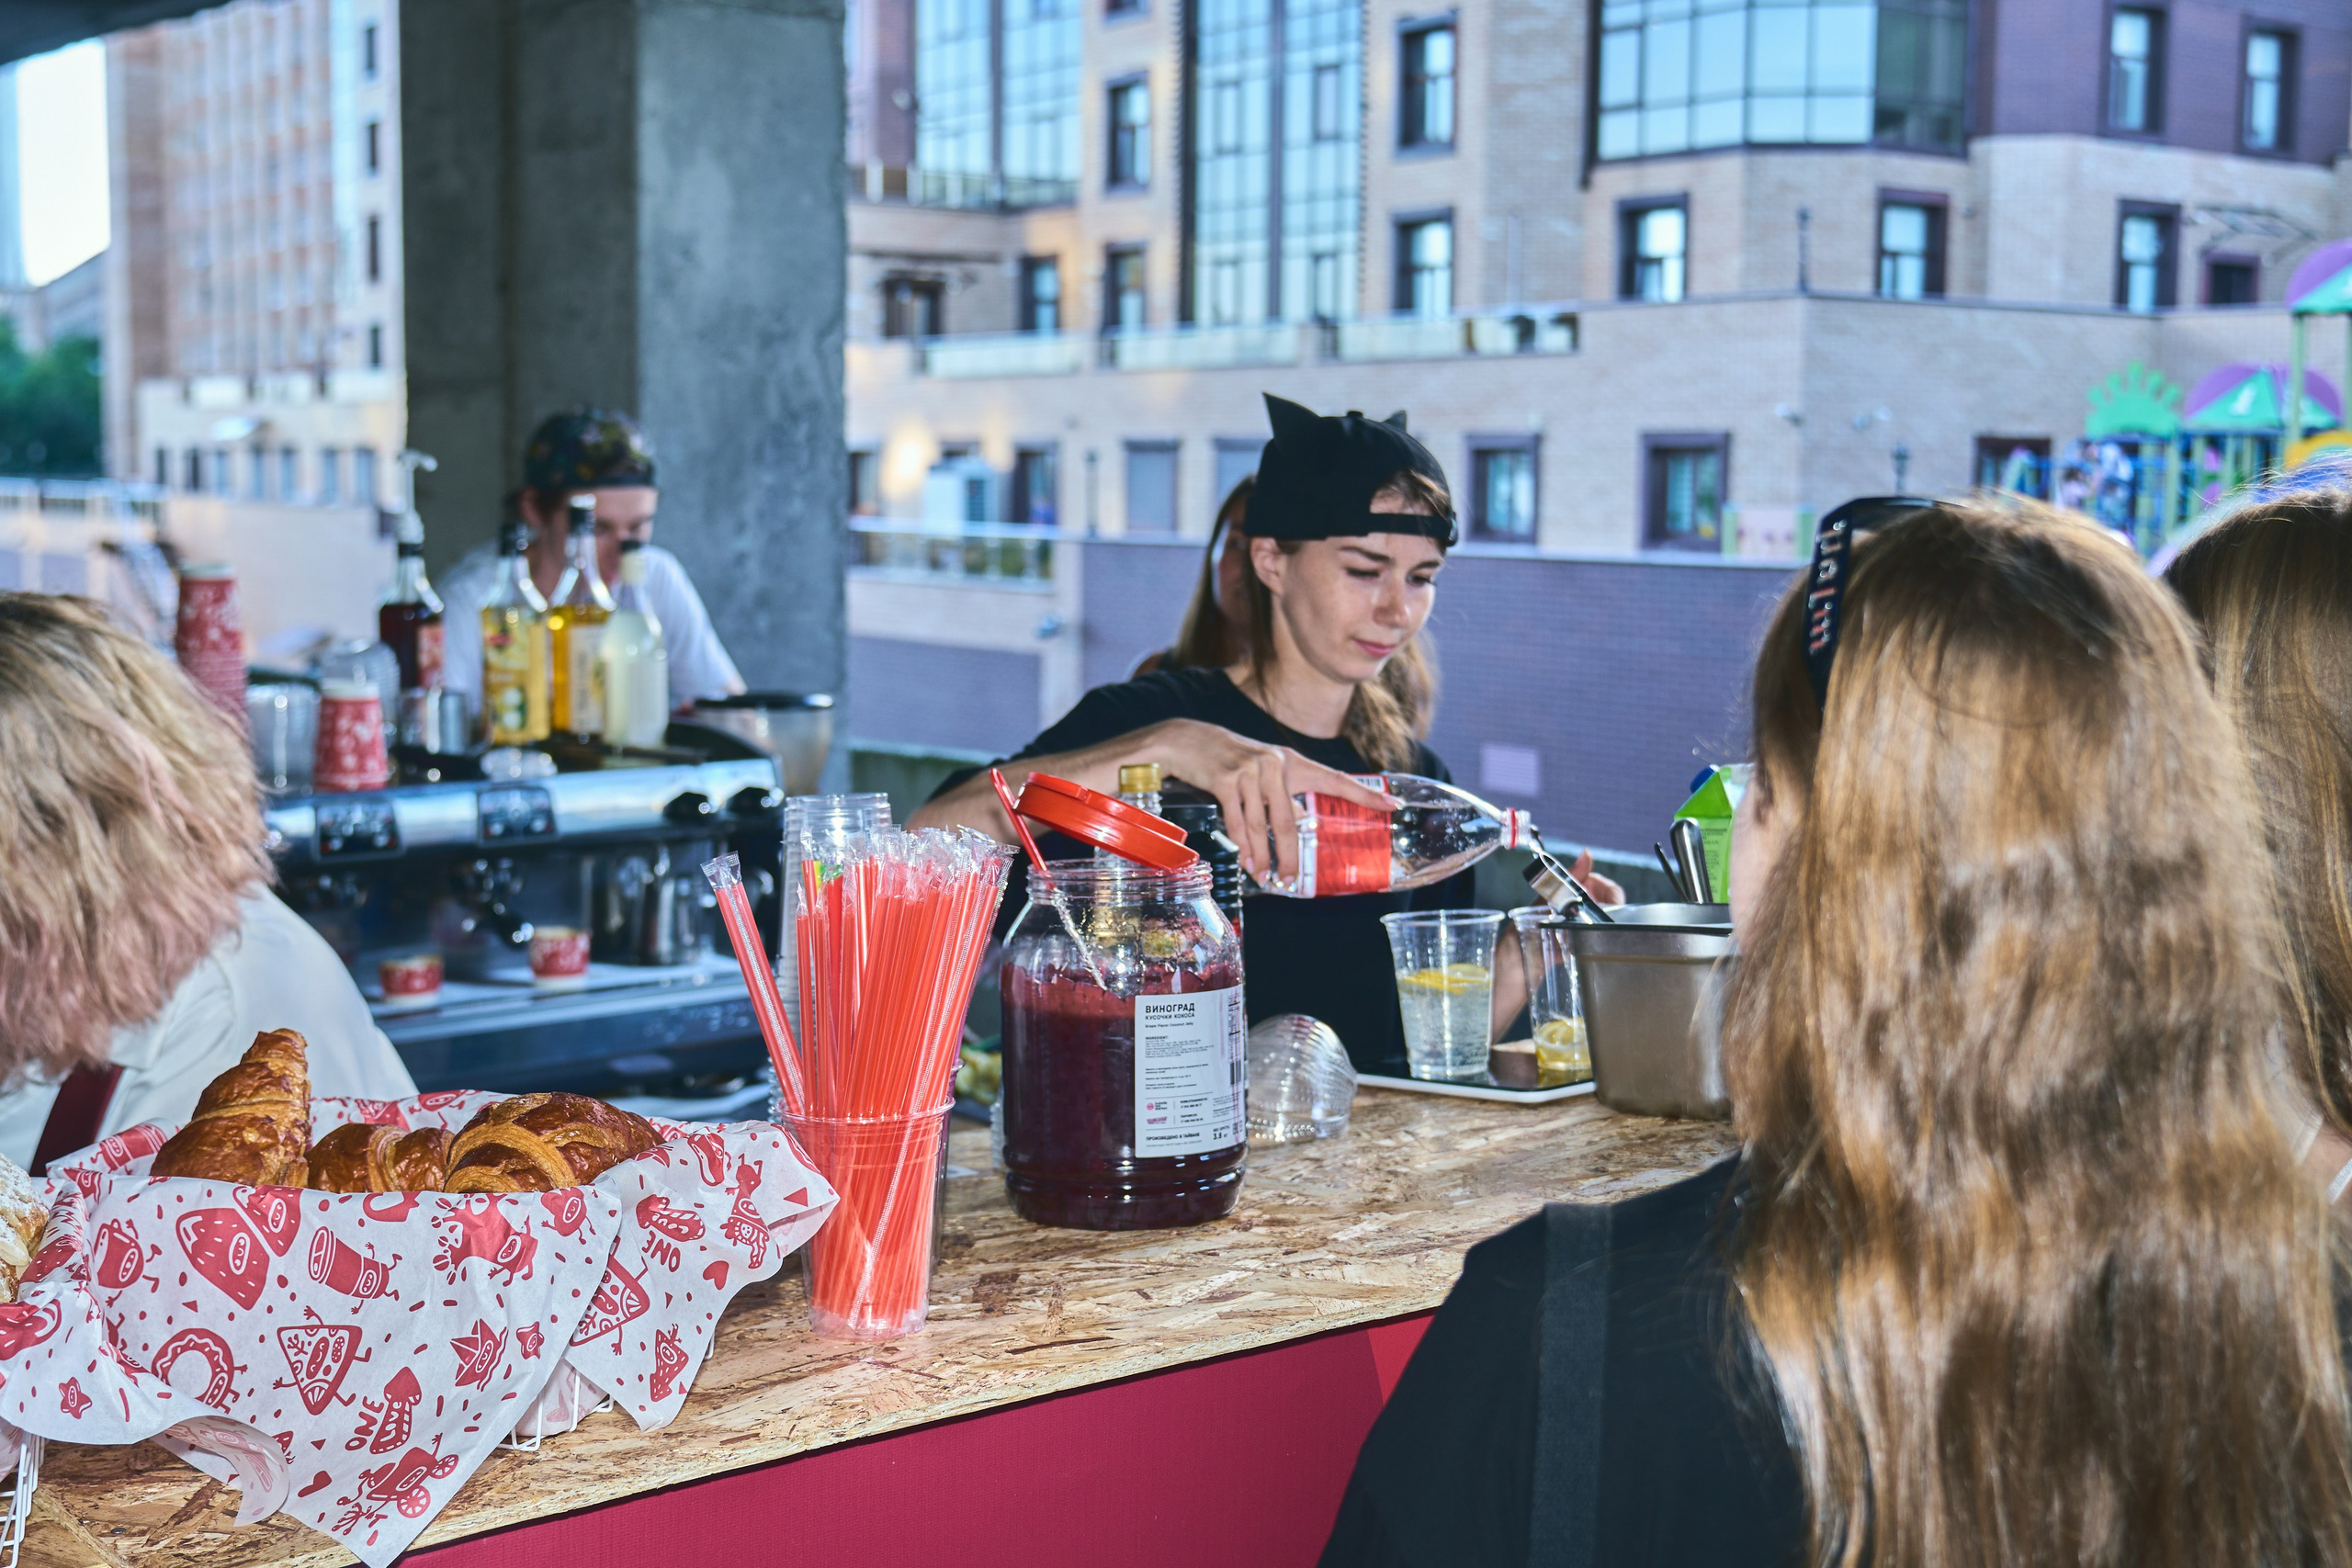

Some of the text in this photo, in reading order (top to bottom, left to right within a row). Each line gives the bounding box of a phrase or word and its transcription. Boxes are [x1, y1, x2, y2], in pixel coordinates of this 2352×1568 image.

[1145, 1002, 1195, 1014] ВИНОГРАД
[1145, 1134, 1179, 1142] ПРОИЗВЕДЕНО
[642, 1230, 681, 1273] ONE
[345, 1395, 385, 1451] ONE
